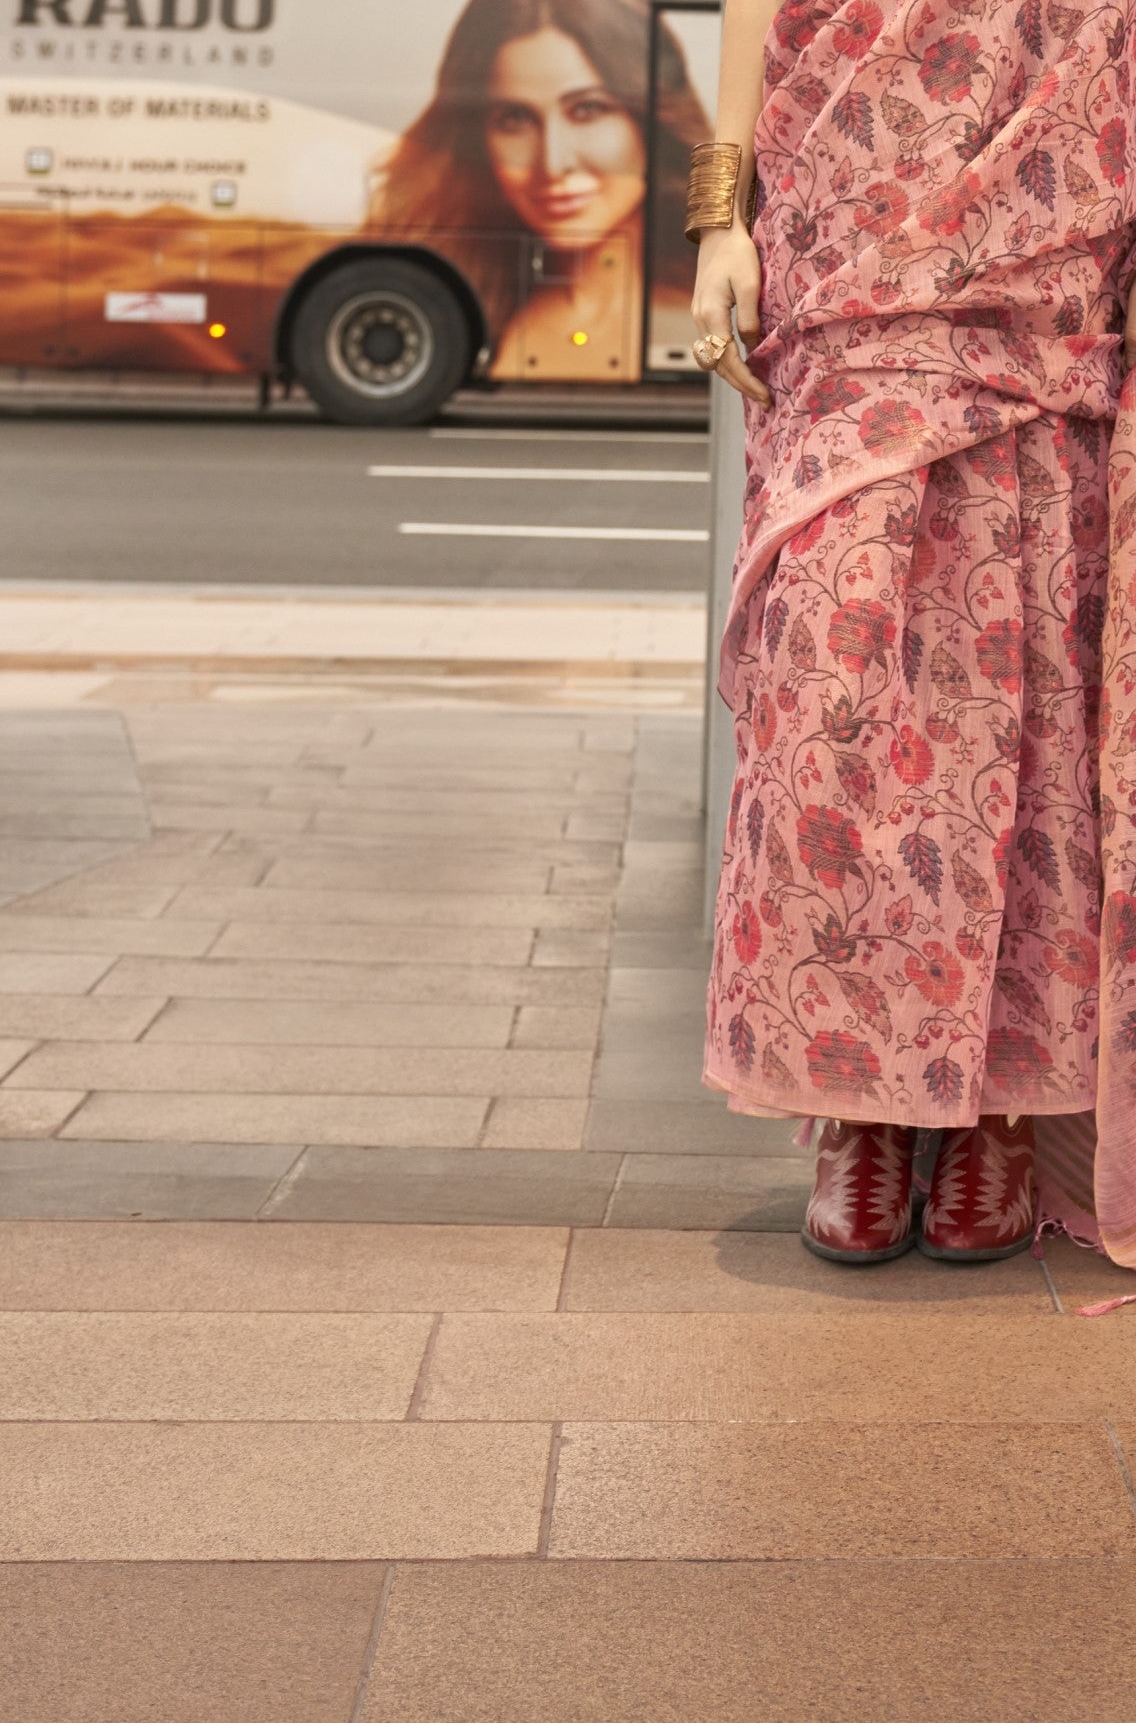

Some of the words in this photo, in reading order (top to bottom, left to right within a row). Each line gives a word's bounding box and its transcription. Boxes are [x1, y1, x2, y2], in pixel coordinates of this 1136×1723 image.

[9, 39, 275, 67] SWITZERLAND
[7, 93, 100, 119] MASTER
[106, 96, 136, 119] OF
[146, 96, 271, 123] MATERIALS
